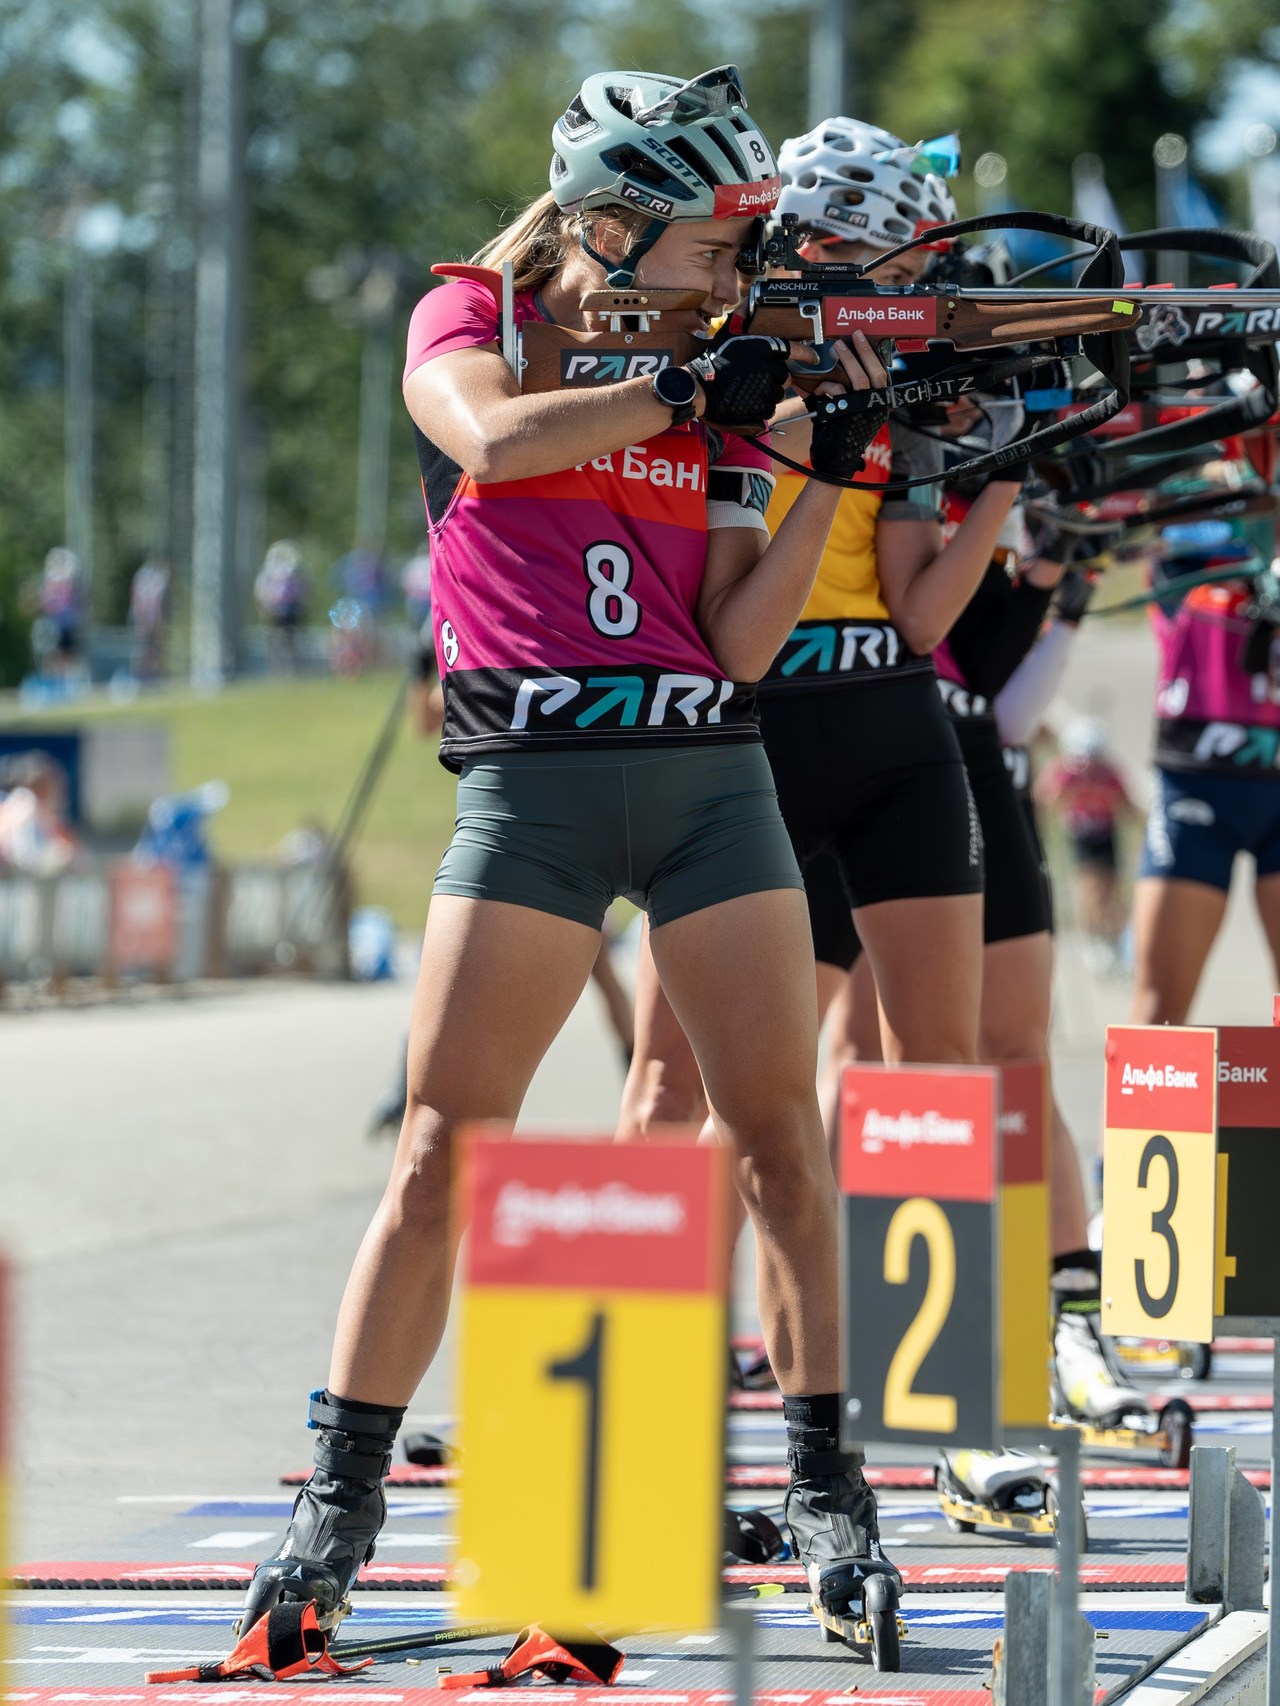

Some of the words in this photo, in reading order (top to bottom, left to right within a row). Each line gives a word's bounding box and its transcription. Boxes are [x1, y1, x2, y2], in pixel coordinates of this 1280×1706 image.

[642, 137, 708, 189] SCOTT
[749, 140, 766, 164] 8
[623, 187, 671, 213] PARI
[738, 191, 772, 212] Альфа
[836, 306, 886, 326] Альфа
[888, 307, 925, 321] Банк
[565, 355, 670, 380] PARI
[622, 445, 706, 493] Бан
[583, 539, 642, 639] 8
[441, 619, 459, 668] 8
[781, 625, 899, 677] ARI
[509, 673, 735, 729] PARI
[1121, 1062, 1164, 1095] Альфа
[1164, 1065, 1198, 1089] Банк
[1217, 1061, 1268, 1083] Банк
[1134, 1134, 1179, 1319] 3
[882, 1197, 957, 1434] 2
[545, 1308, 608, 1597] 1
